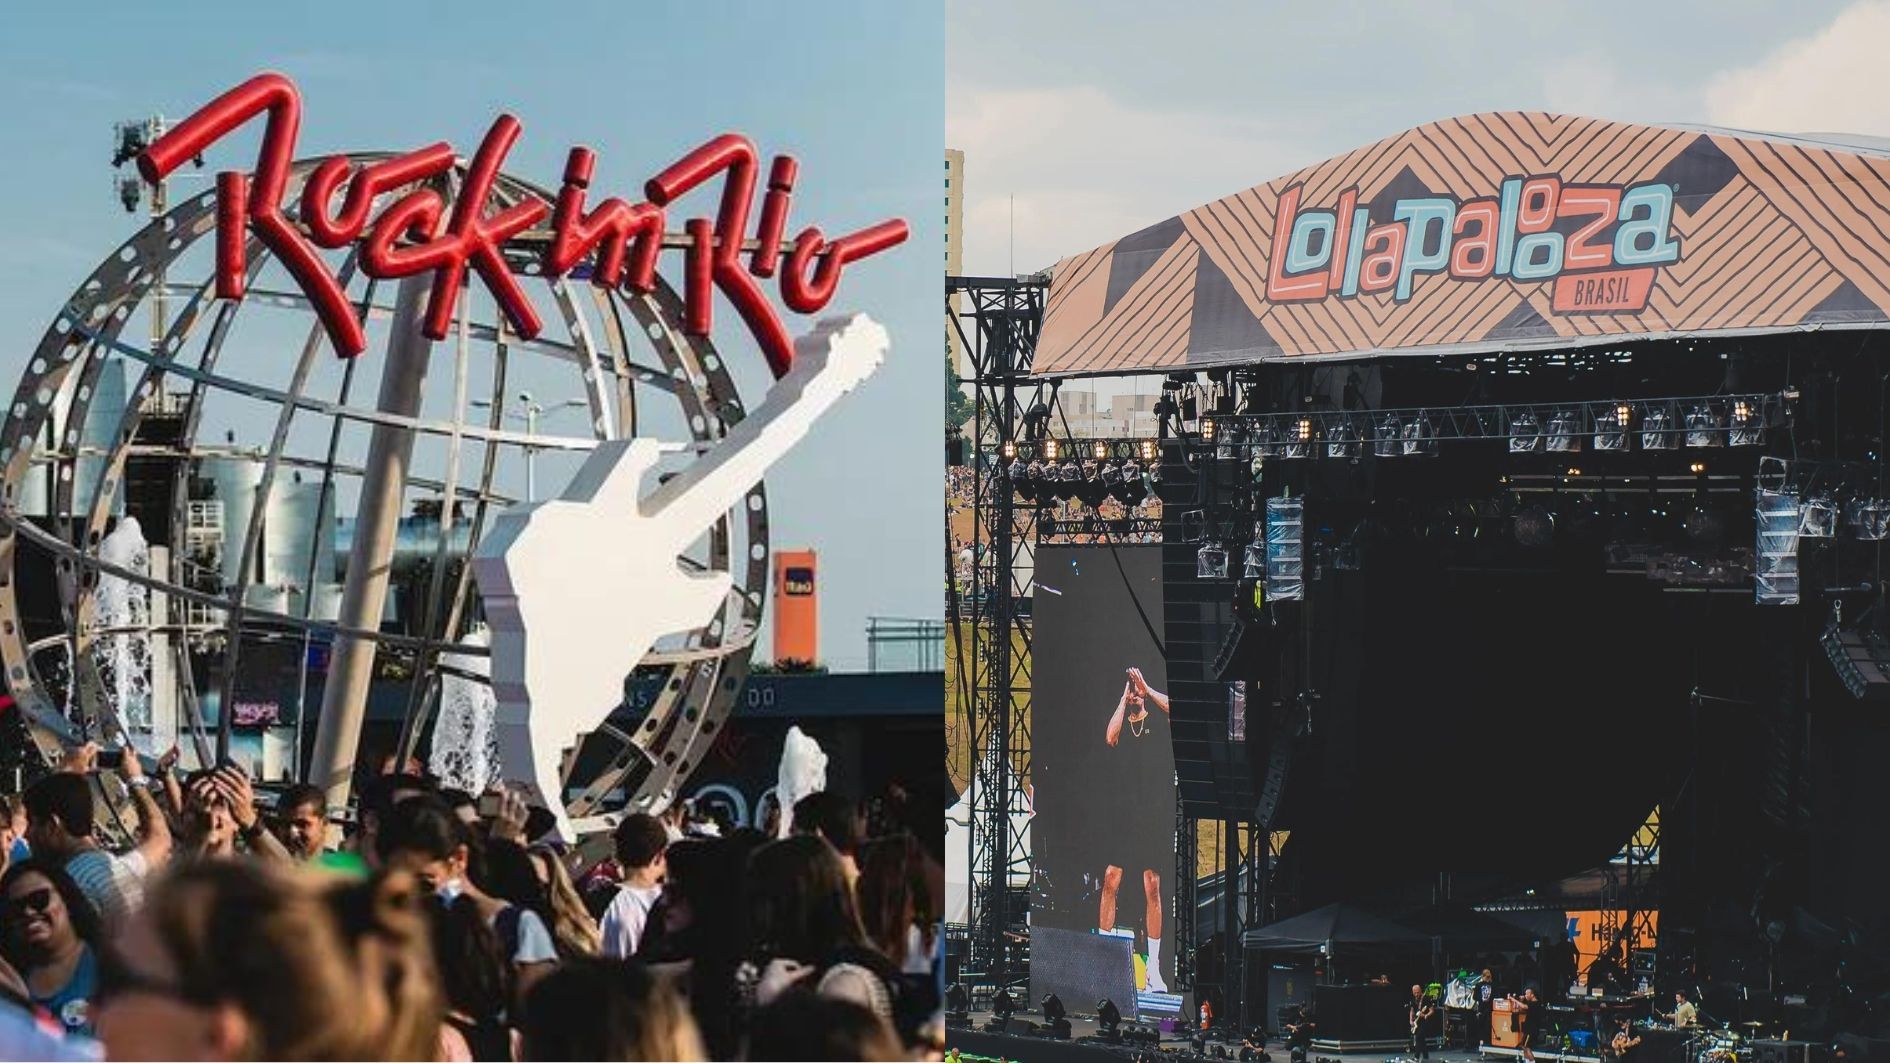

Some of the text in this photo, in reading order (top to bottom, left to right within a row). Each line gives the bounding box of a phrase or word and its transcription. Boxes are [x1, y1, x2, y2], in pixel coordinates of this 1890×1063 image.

[137, 72, 910, 379] Rock in Rio
[1266, 175, 1680, 302] Lollapalooza
[1574, 276, 1630, 305] BRASIL
